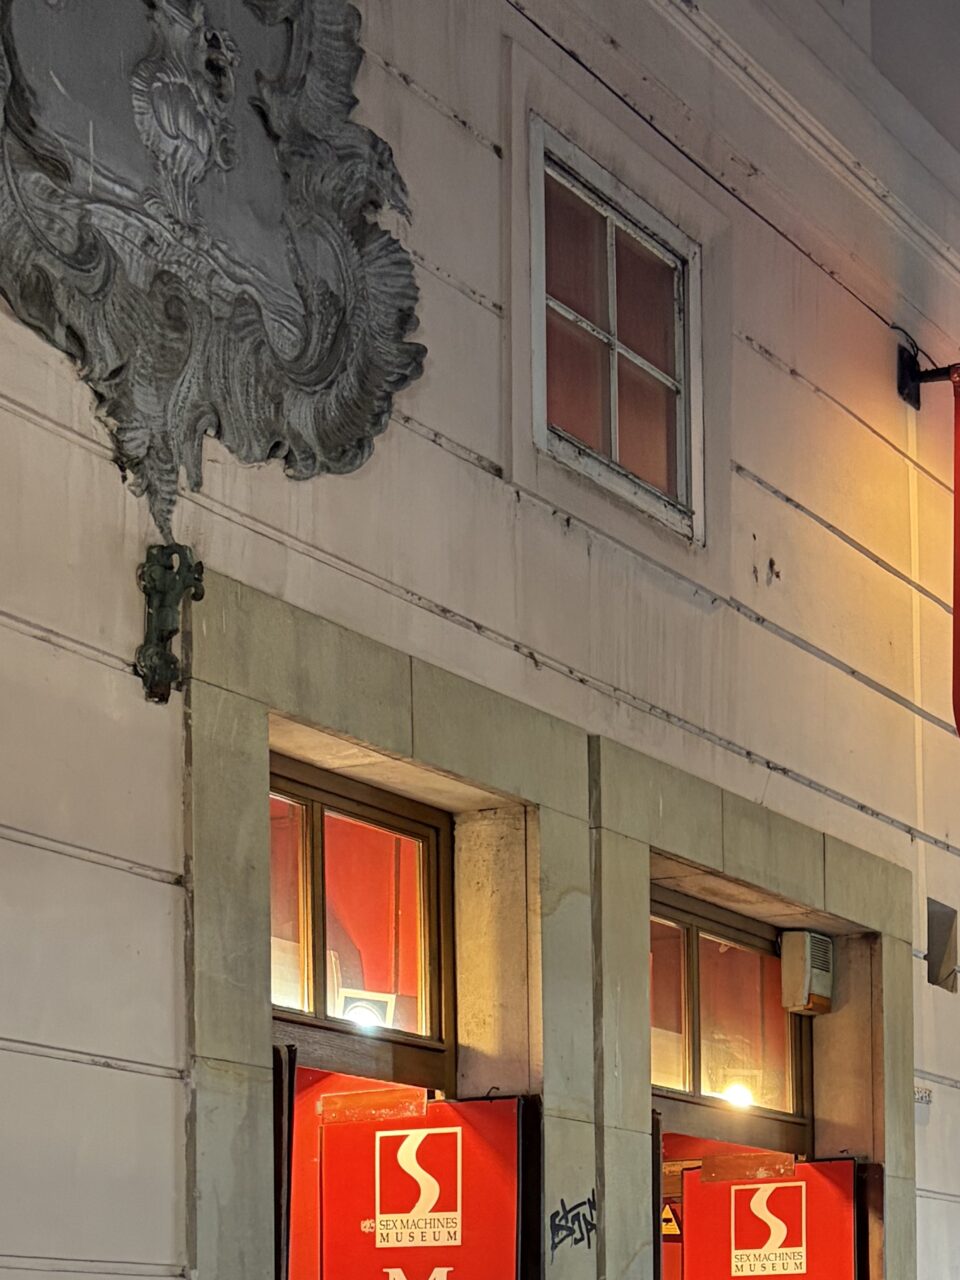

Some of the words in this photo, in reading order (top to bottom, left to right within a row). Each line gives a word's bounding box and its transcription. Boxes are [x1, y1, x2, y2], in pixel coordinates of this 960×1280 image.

[379, 1219, 398, 1231] SEX
[400, 1217, 458, 1230] MACHINES
[379, 1230, 457, 1243] MUSEUM
[734, 1253, 752, 1263] SEX
[753, 1251, 803, 1262] MACHINES
[734, 1261, 803, 1273] MUSEUM
